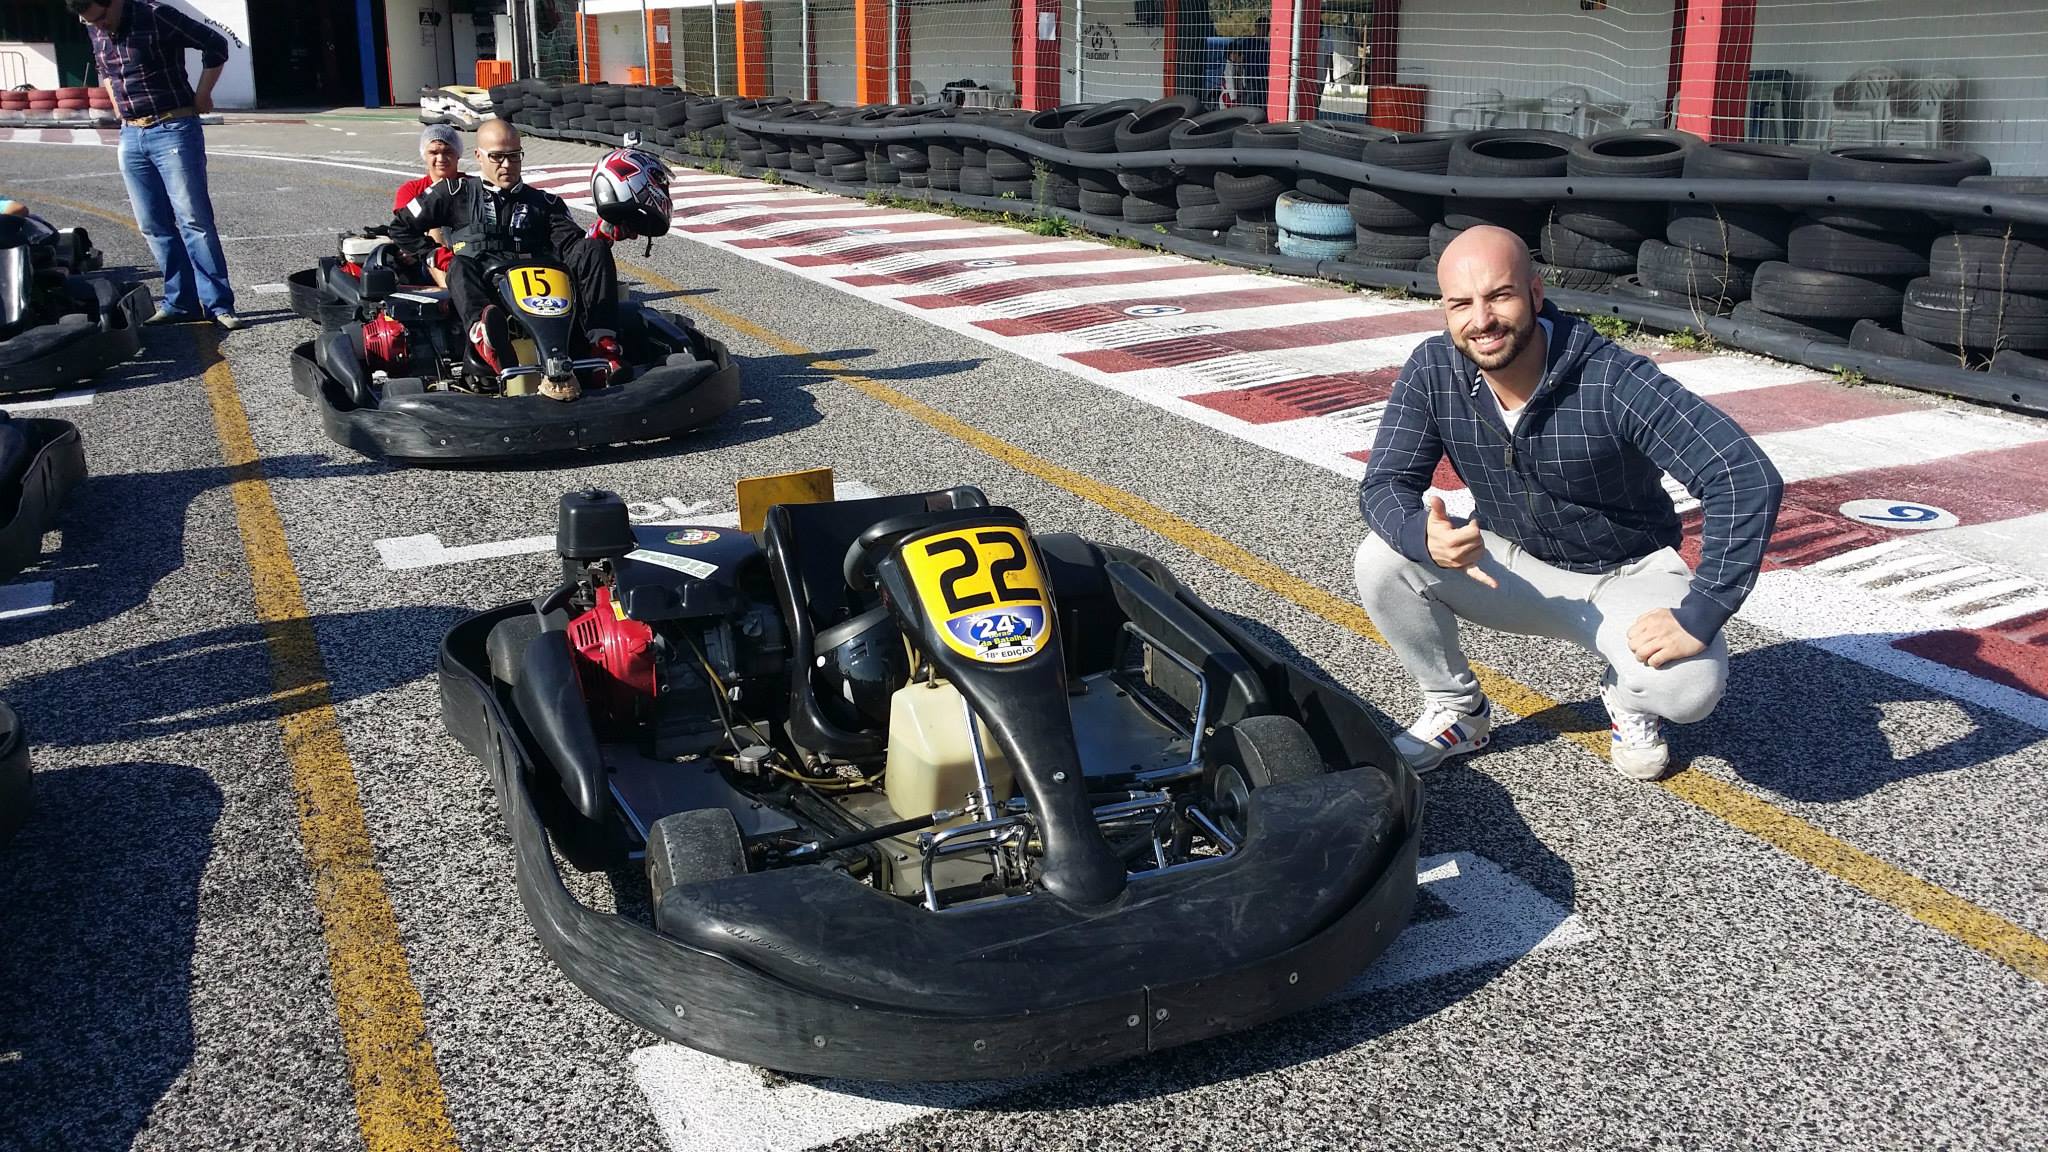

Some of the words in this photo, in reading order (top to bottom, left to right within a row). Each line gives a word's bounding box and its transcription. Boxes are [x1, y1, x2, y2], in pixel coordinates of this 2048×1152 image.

[204, 17, 243, 49] KARTING
[521, 269, 552, 297] 15
[924, 530, 1042, 615] 22
[976, 615, 1015, 639] 24
[980, 640, 993, 648] da
[994, 634, 1027, 645] Batalha
[1001, 645, 1034, 658] EDIÇÃO
